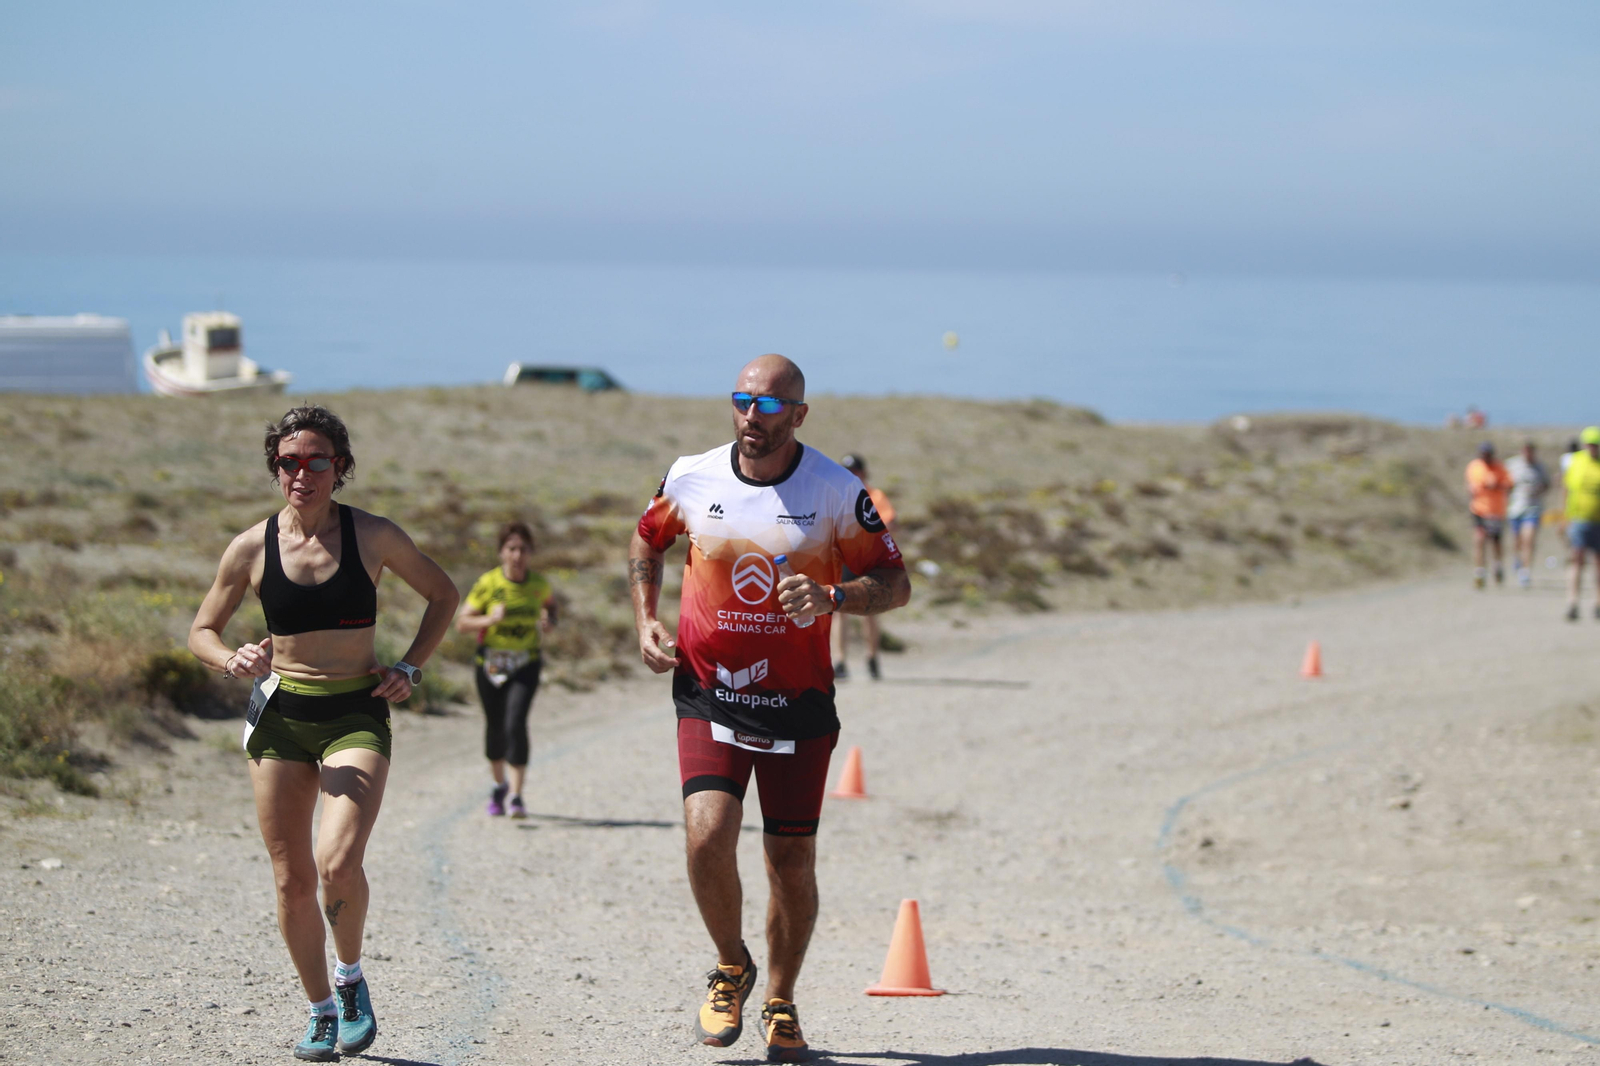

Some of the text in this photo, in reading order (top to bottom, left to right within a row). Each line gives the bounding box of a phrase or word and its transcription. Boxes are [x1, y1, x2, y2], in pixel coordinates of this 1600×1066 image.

[718, 621, 786, 634] SALINAS CAR
[715, 689, 788, 708] Europack
